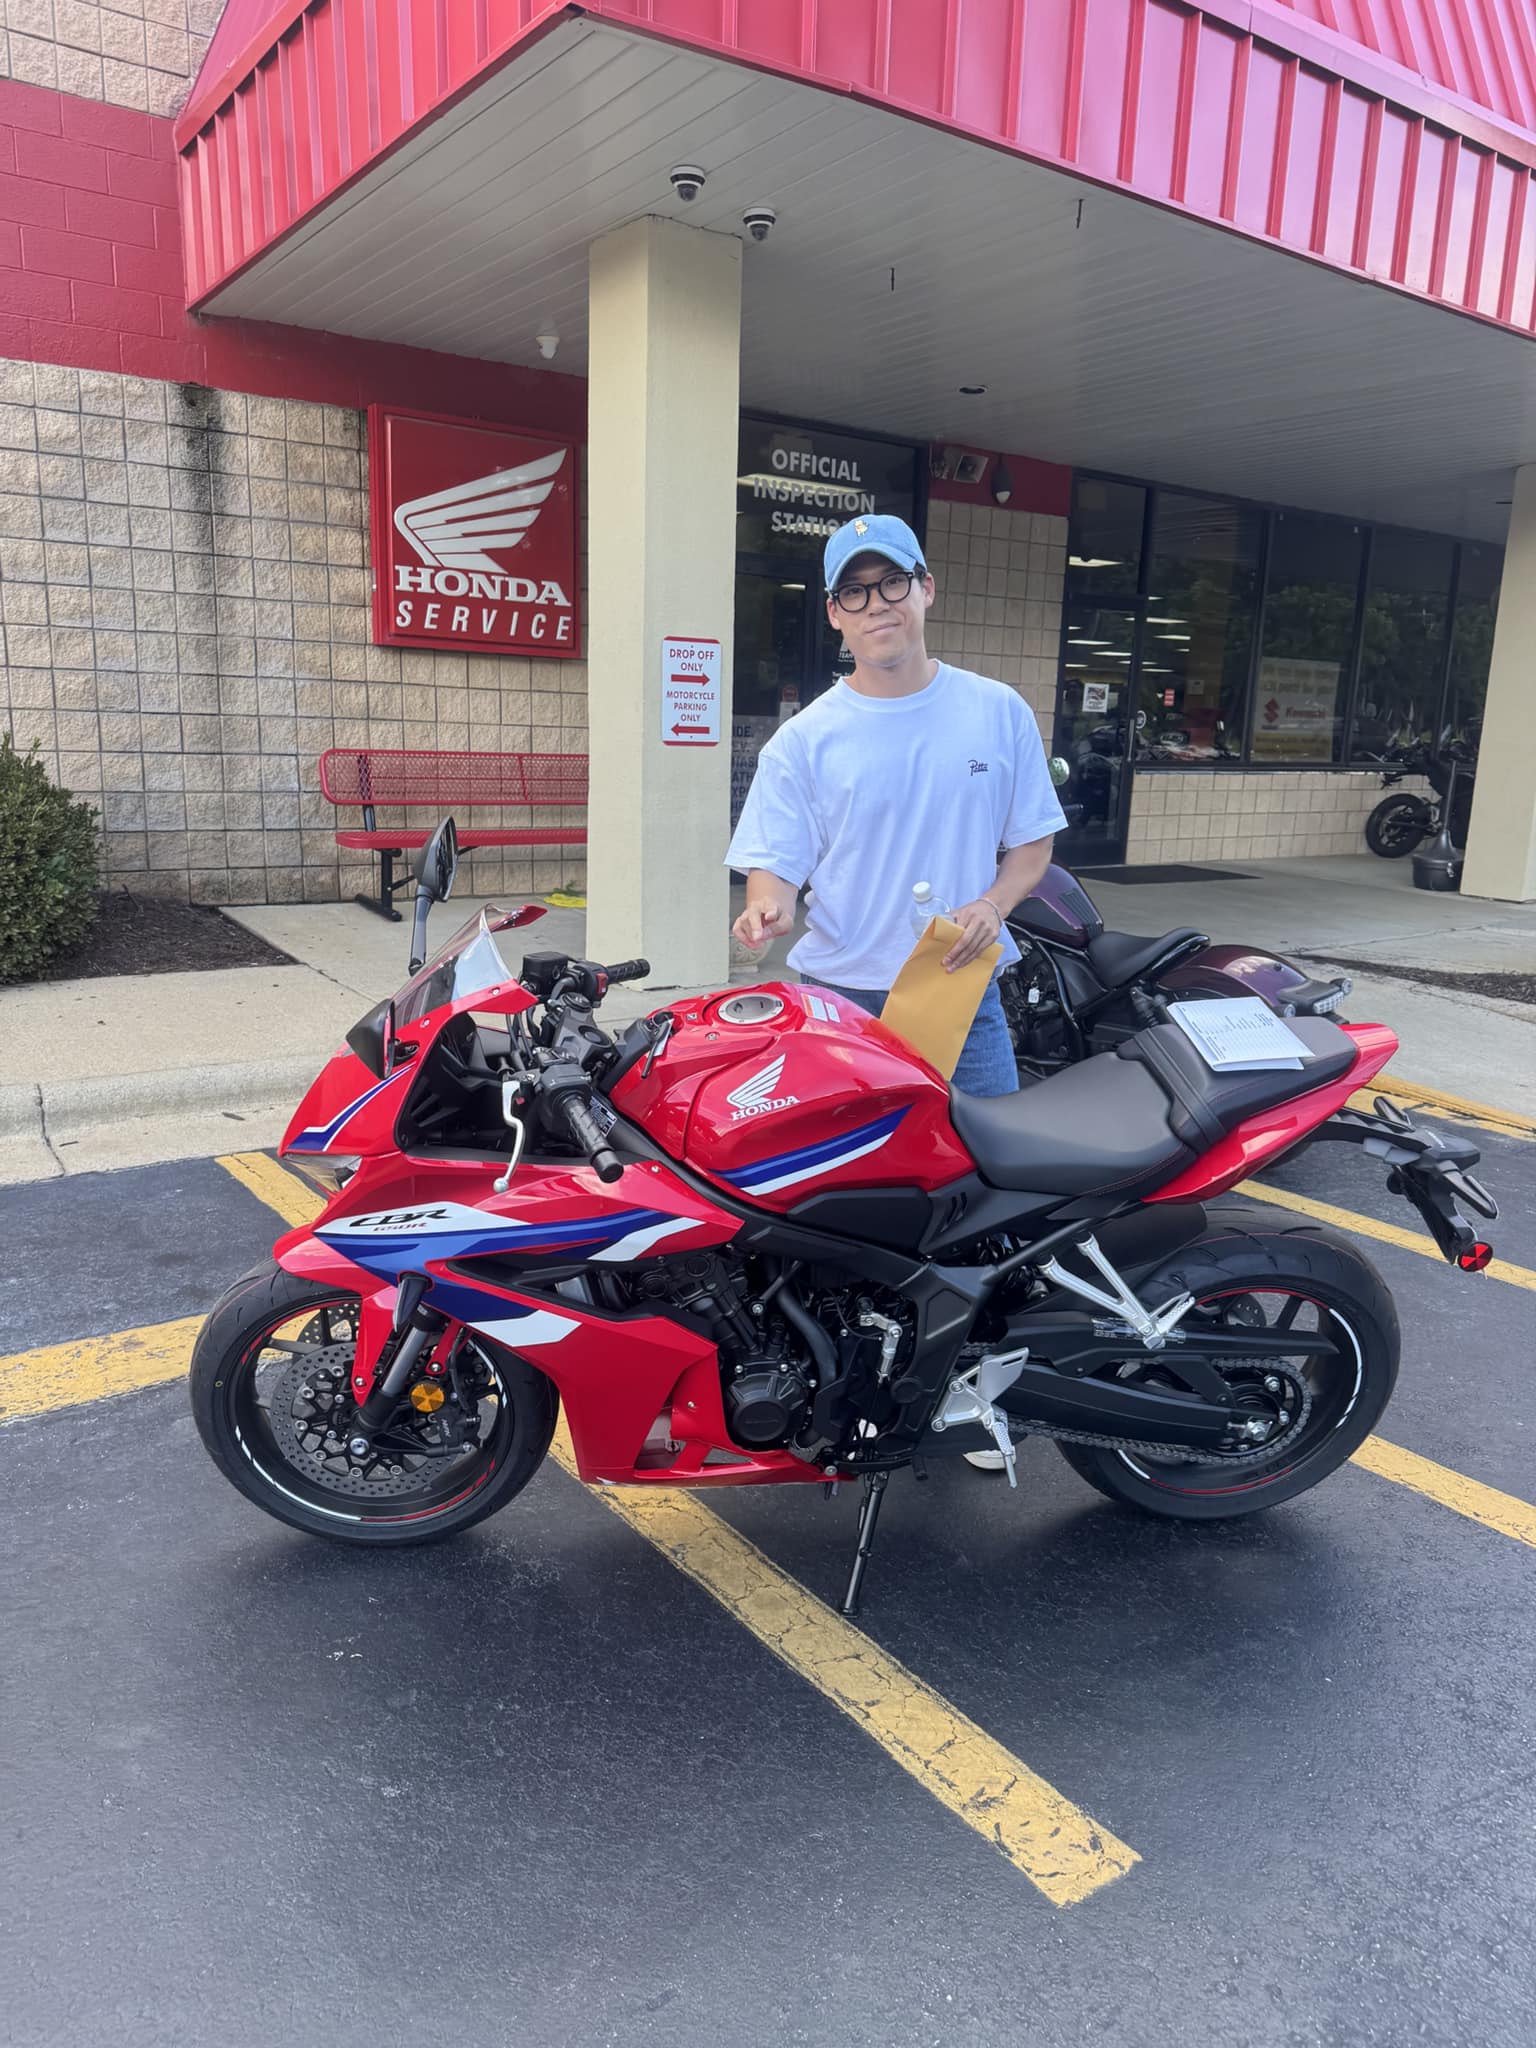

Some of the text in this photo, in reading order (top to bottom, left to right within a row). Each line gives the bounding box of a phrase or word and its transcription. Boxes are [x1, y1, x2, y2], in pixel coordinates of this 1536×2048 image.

[771, 448, 861, 483] OFFICIAL
[753, 476, 876, 514] INSPECTION
[771, 510, 848, 537] STATIO
[394, 564, 572, 607] HONDA
[396, 599, 572, 641] SERVICE
[669, 648, 715, 660] DROP OFF
[680, 662, 704, 672] ONLY
[666, 690, 716, 701] MOTORCYCLE
[673, 702, 707, 712] PARKING
[680, 713, 701, 722] ONLY
[732, 1095, 800, 1121] HONDA
[349, 1208, 452, 1228] CBR
